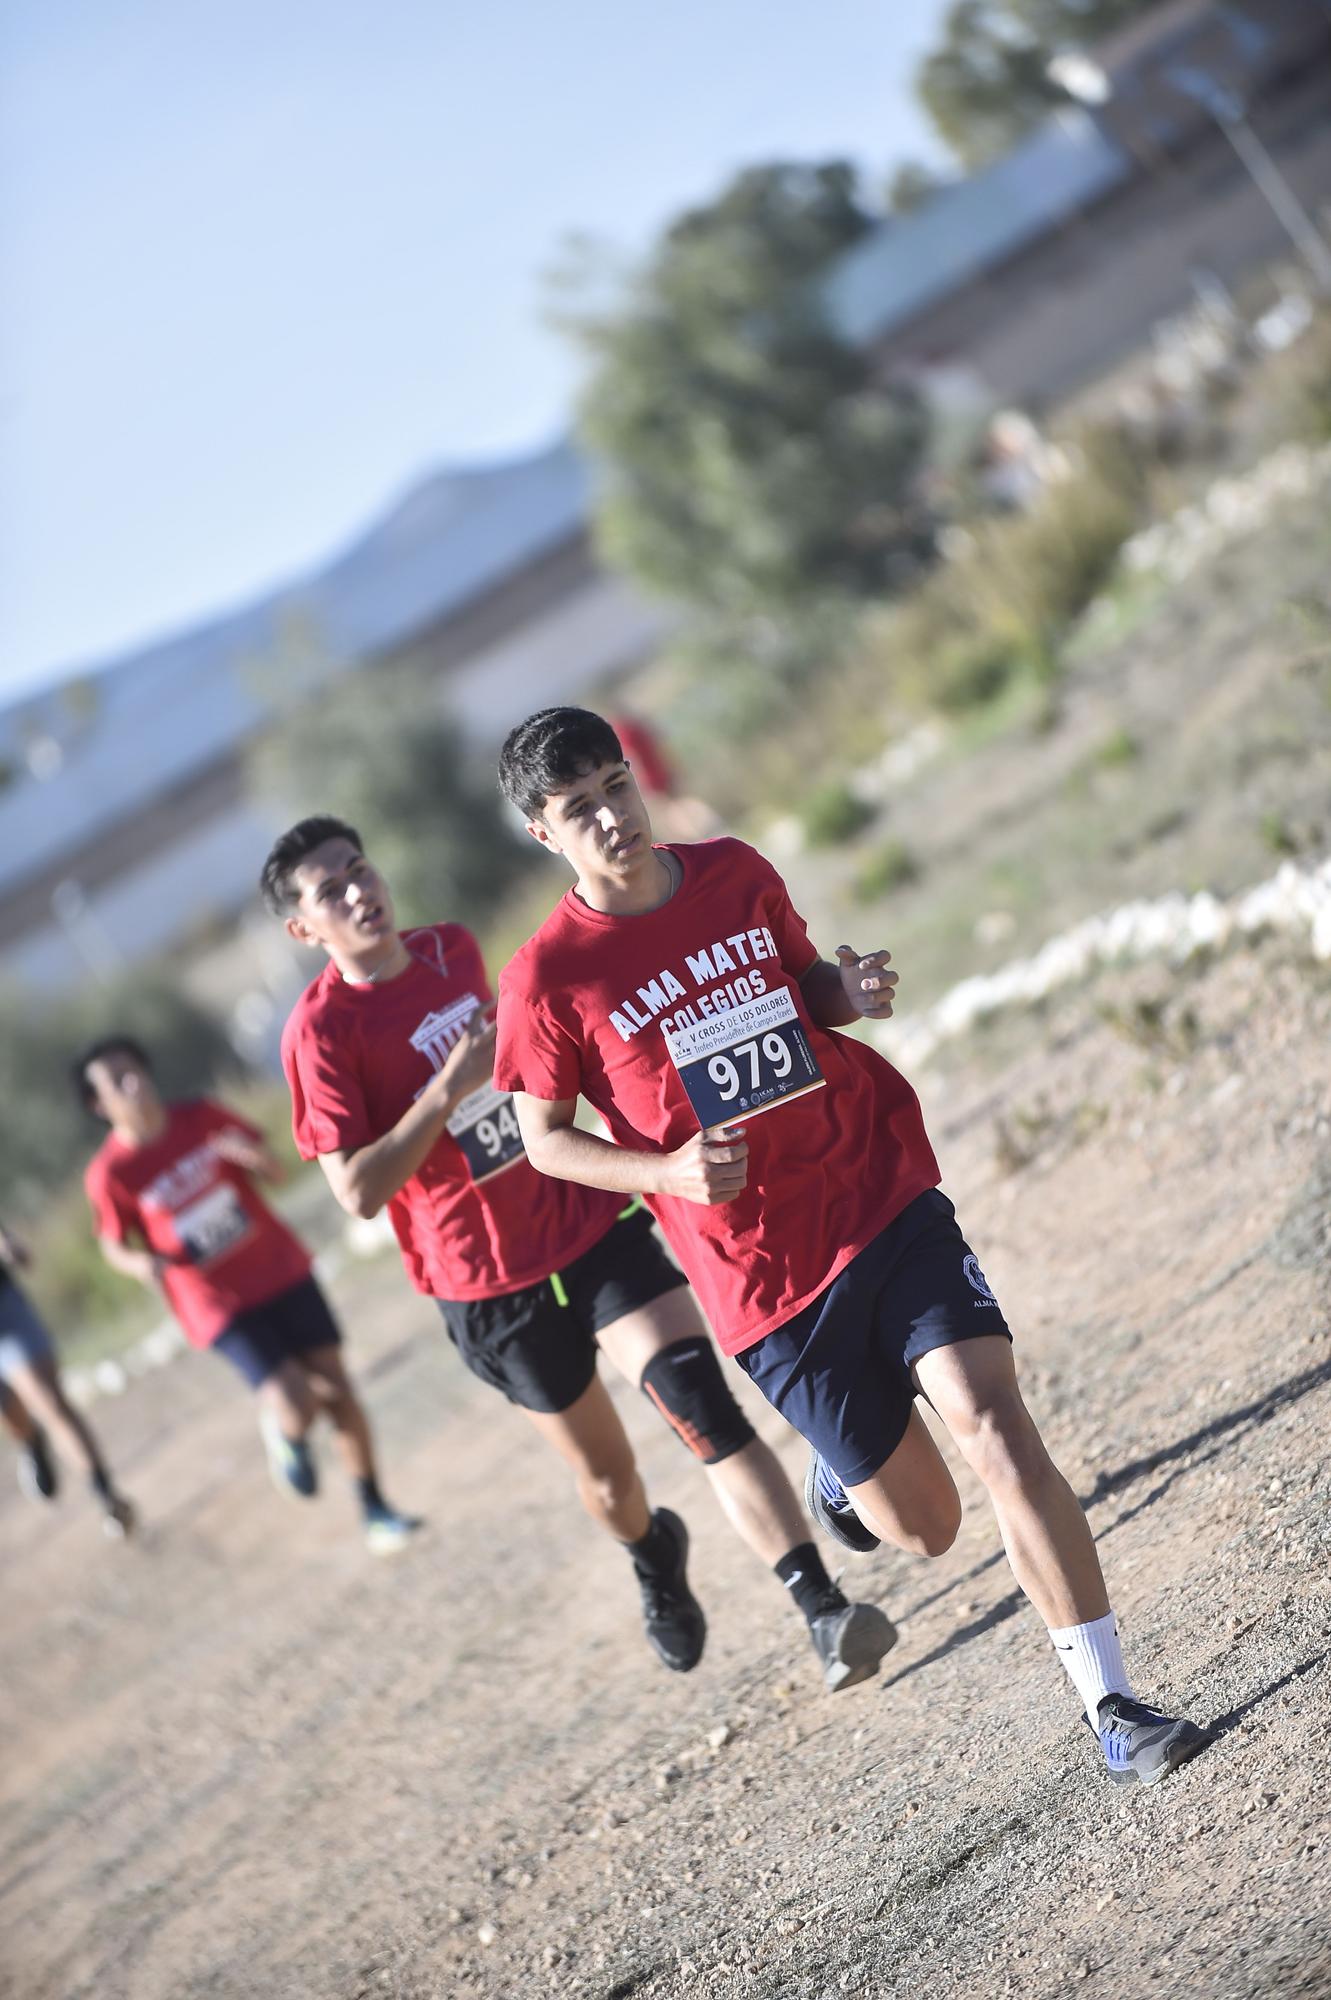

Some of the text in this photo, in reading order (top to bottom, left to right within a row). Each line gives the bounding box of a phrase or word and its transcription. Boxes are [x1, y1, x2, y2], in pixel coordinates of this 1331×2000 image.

[608, 927, 778, 1043] ALMA MATER
[659, 969, 767, 1037] COLEGIOS
[689, 994, 789, 1043] V CROSS DE LOS DOLORES
[694, 1040, 714, 1054] Trofeo
[713, 1026, 746, 1048] Presidente
[753, 1015, 774, 1029] Campo
[707, 1032, 792, 1101] 979
[475, 1102, 520, 1158] 94
